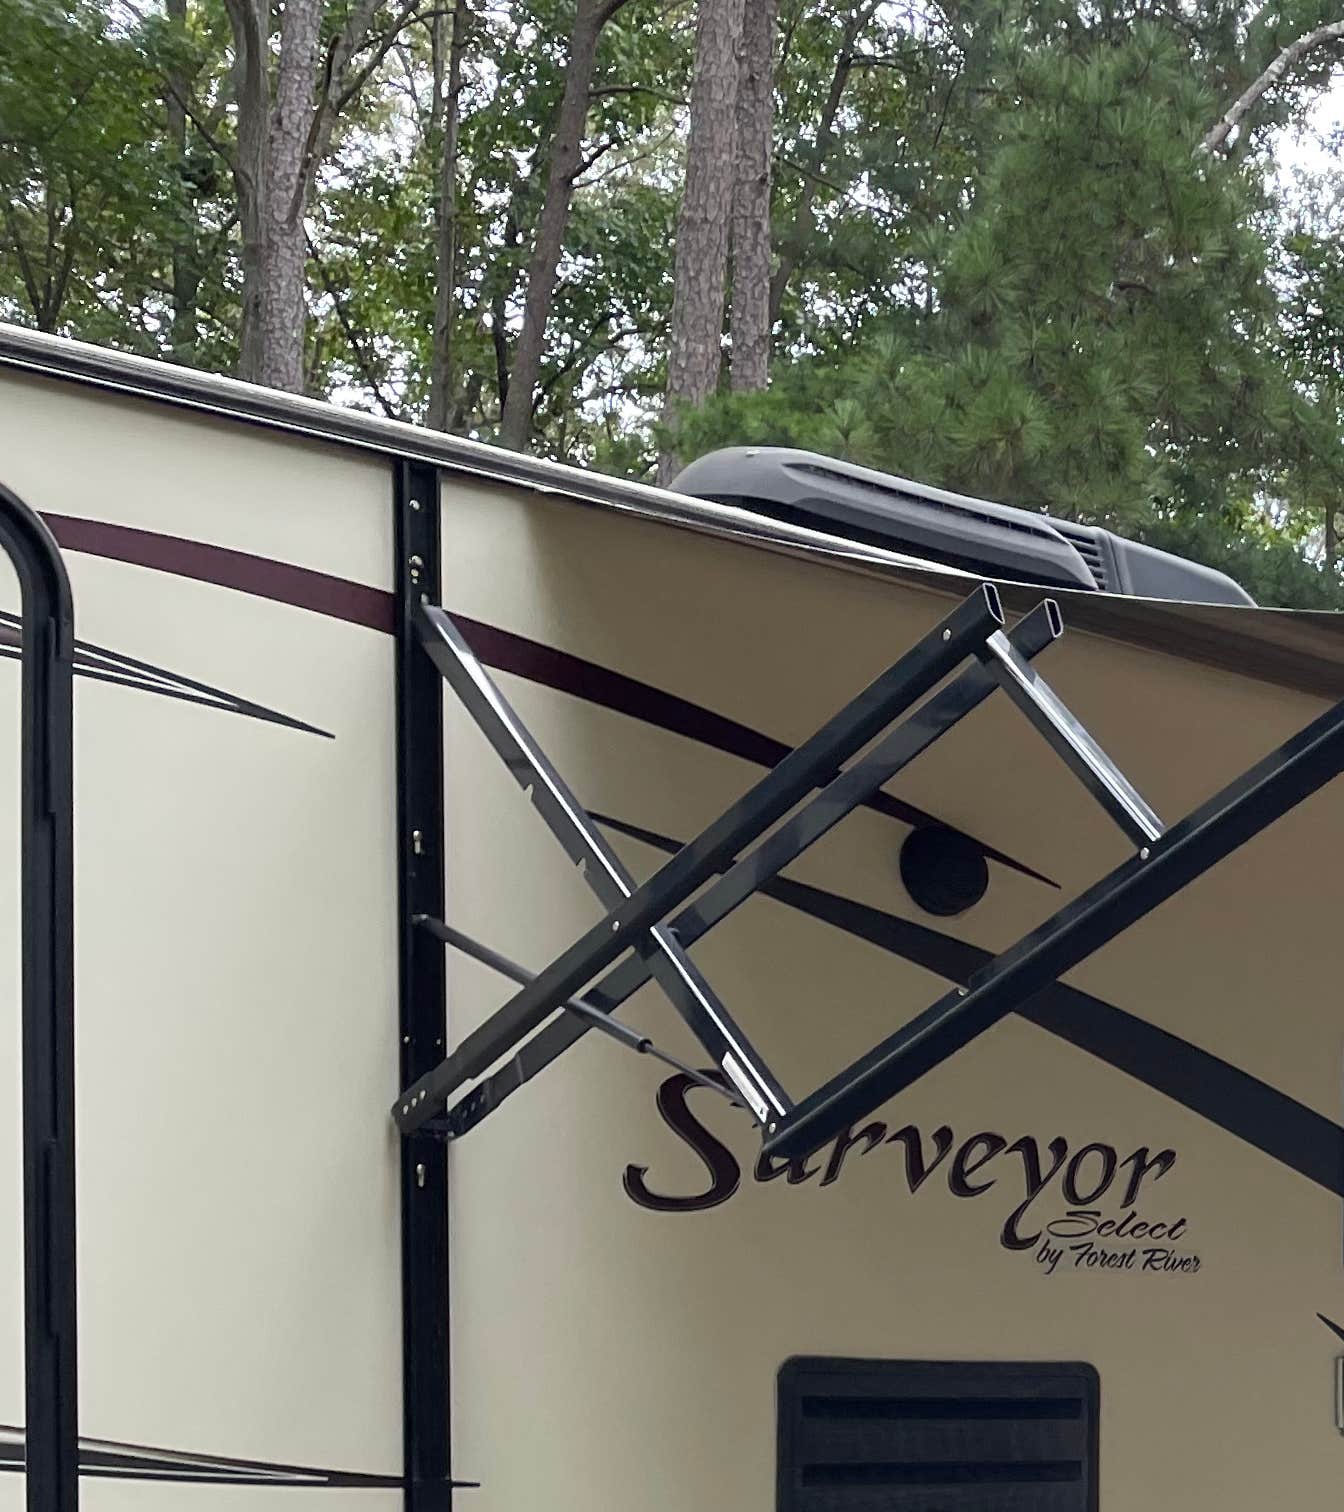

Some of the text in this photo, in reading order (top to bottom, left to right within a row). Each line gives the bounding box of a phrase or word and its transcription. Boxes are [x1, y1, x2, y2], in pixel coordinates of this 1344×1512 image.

[1046, 1210, 1188, 1241] Select
[1036, 1239, 1201, 1276] by Forest River
